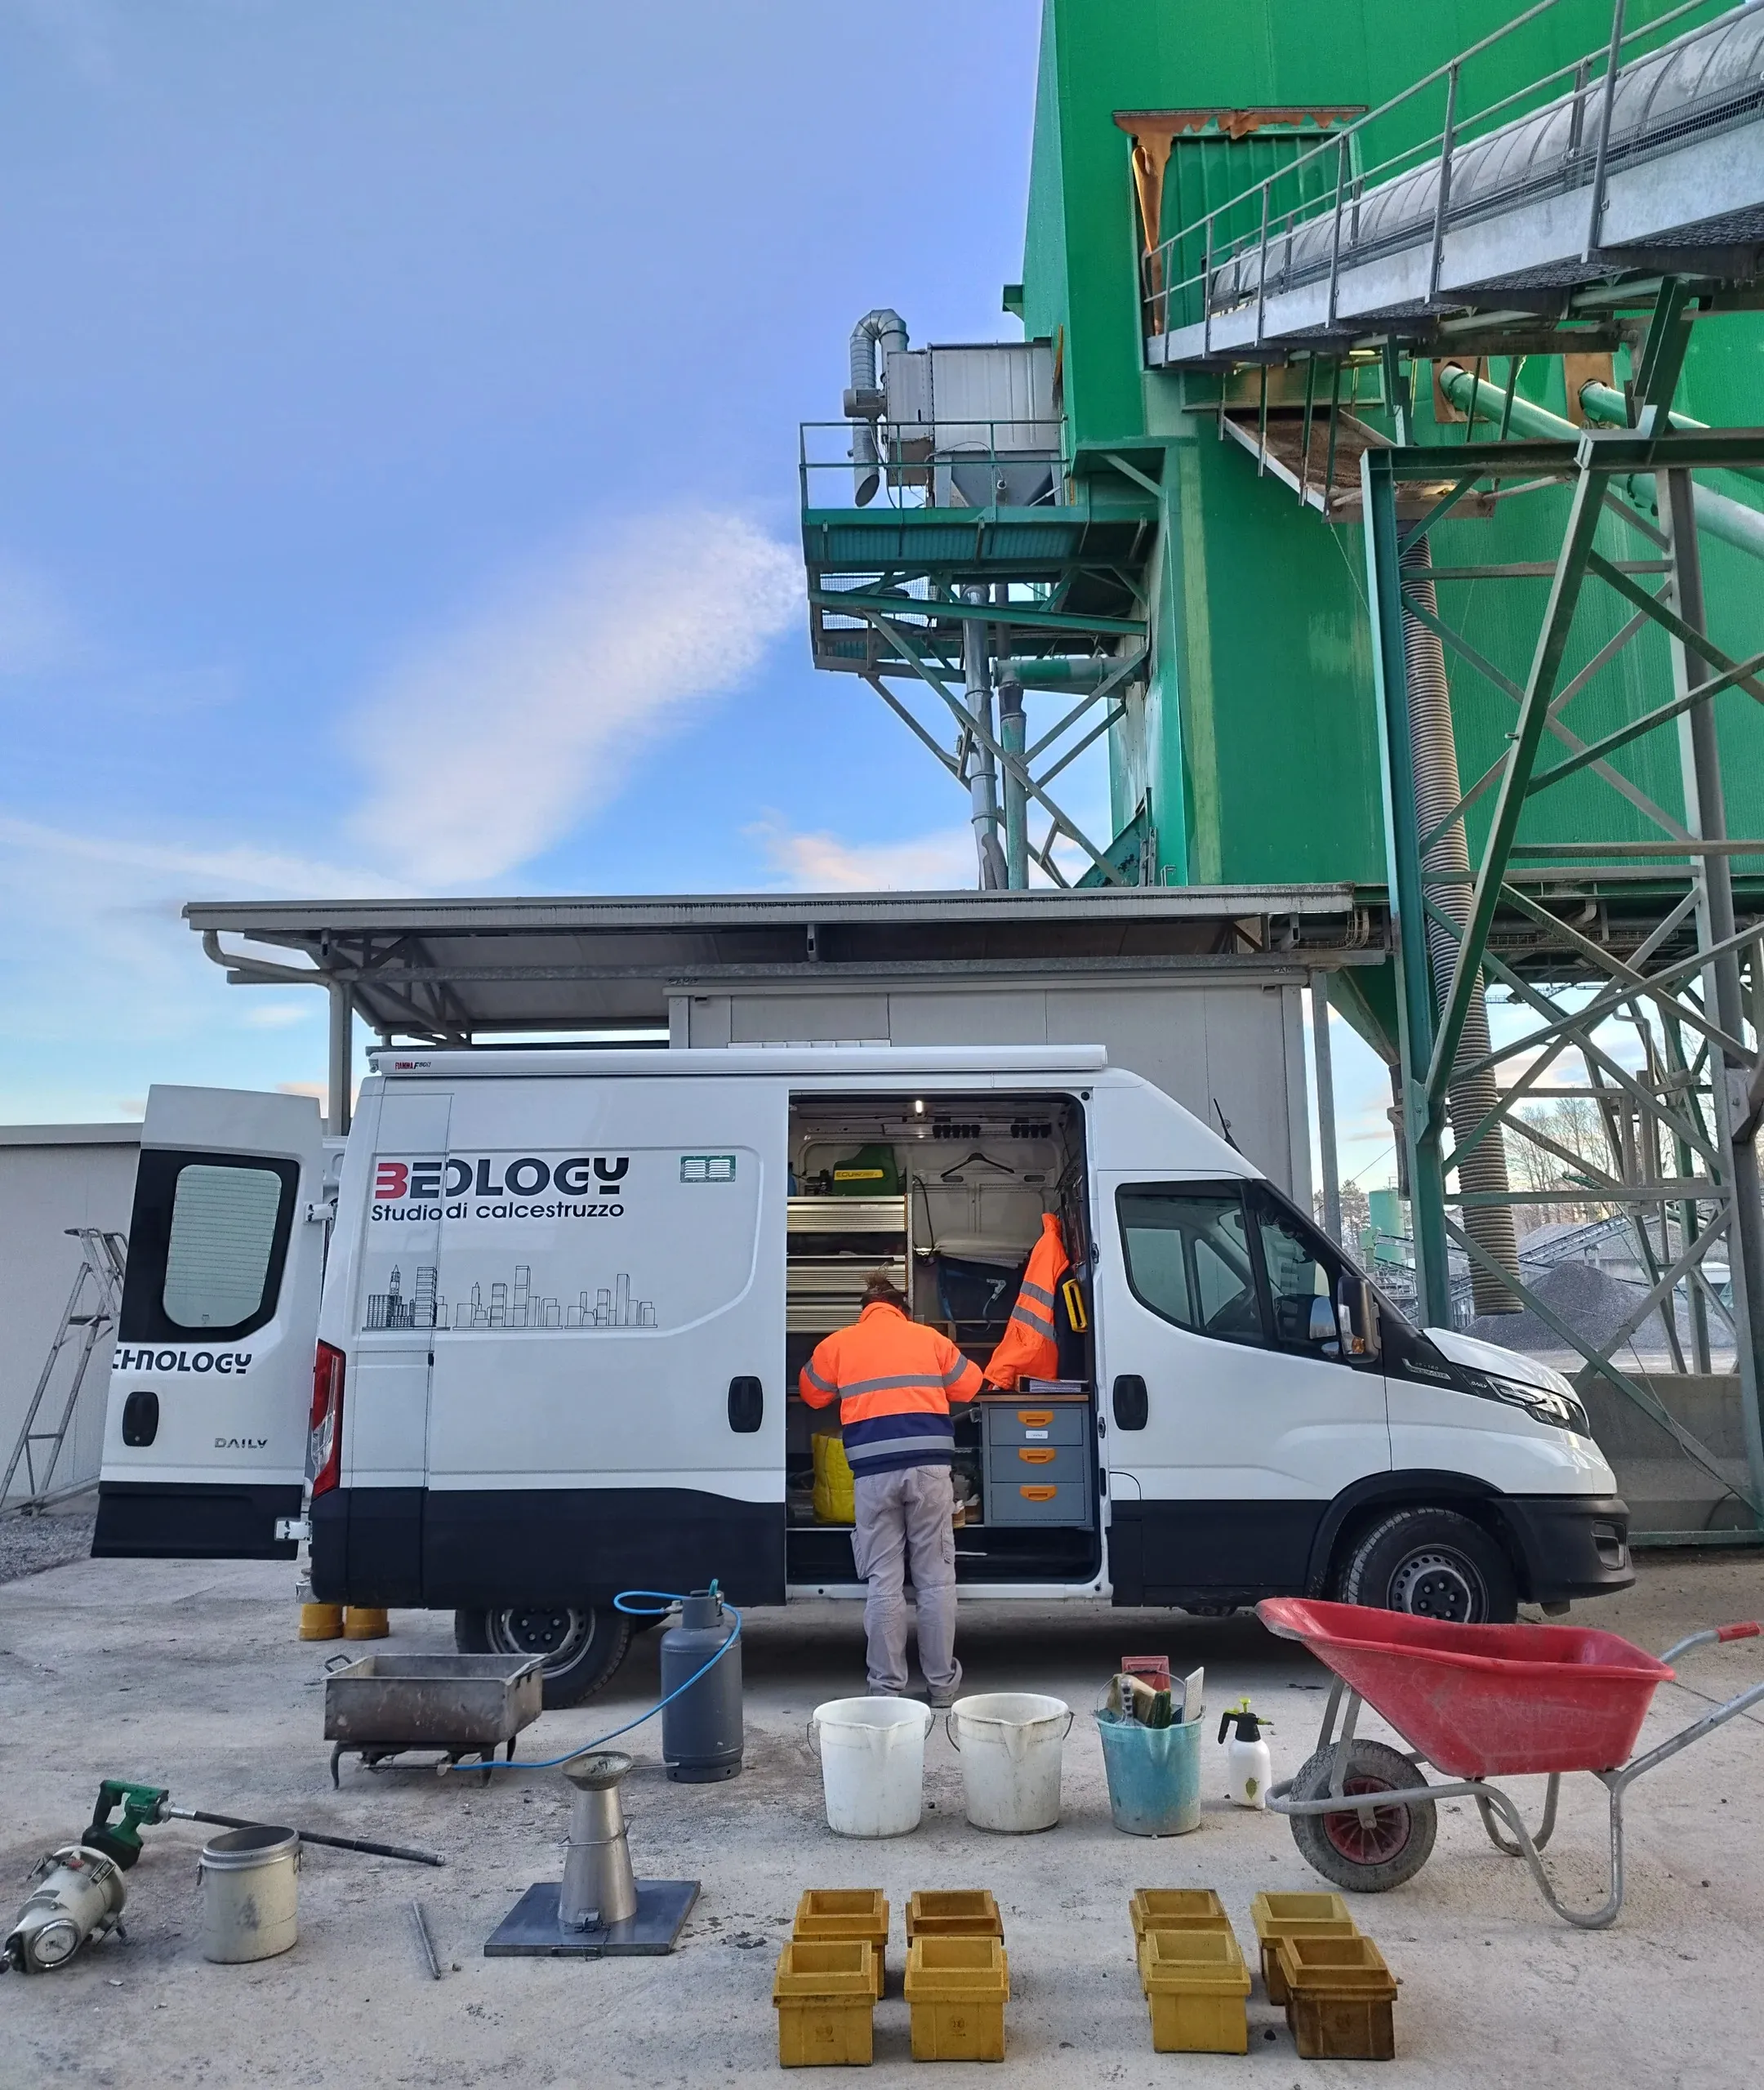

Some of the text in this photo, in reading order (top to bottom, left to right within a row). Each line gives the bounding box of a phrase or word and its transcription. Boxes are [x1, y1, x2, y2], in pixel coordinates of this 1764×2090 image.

[371, 1201, 625, 1222] Studio di calcestruzzo
[214, 1437, 269, 1449] DAILY
